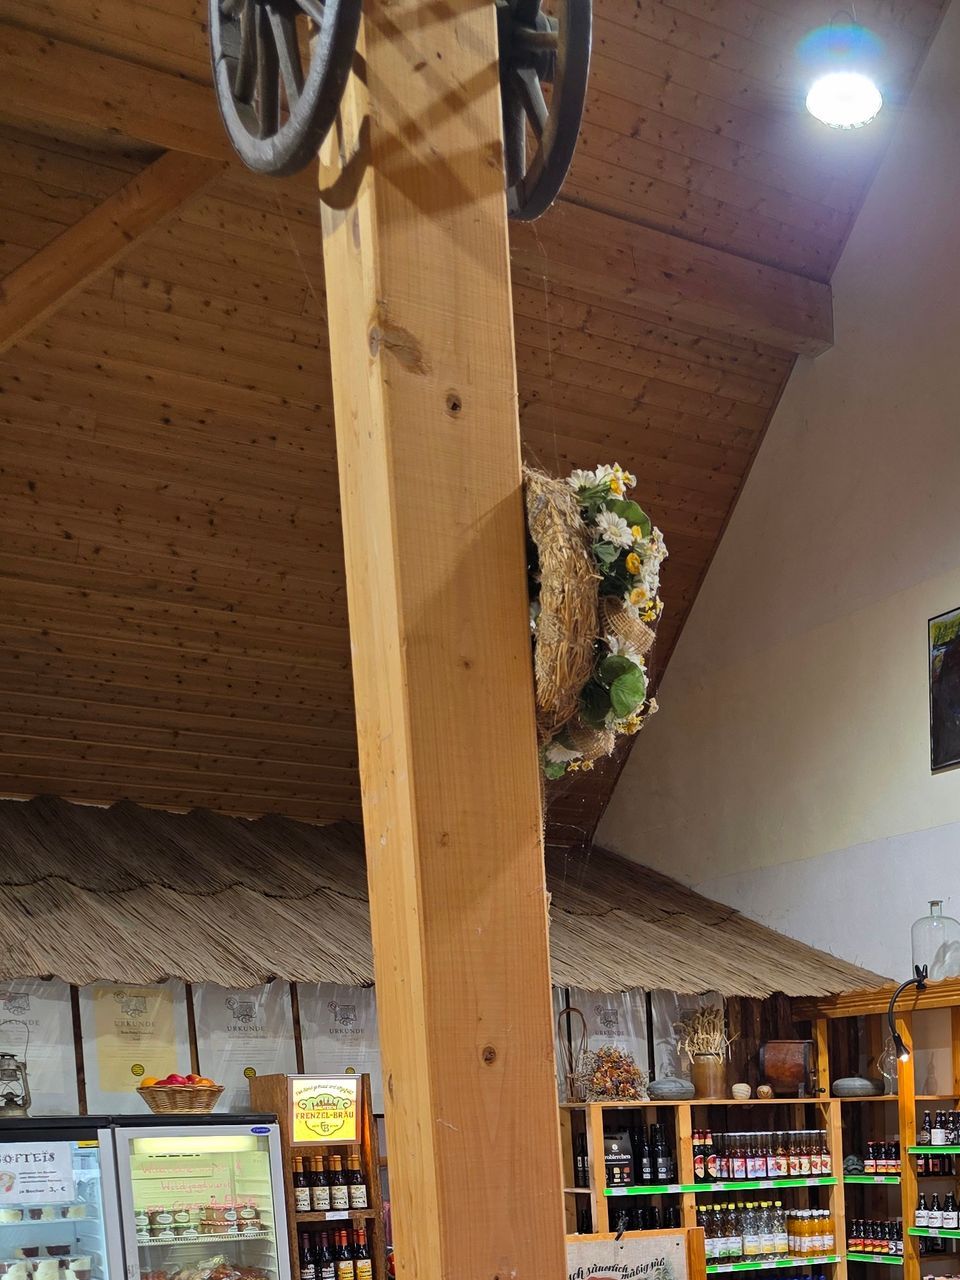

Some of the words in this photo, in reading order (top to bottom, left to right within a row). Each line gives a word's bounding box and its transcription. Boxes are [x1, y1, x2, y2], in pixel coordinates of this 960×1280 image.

[295, 1110, 354, 1120] FRENZEL-BRÄU
[0, 1152, 55, 1163] OFTEIS
[586, 1263, 628, 1277] säuerlich
